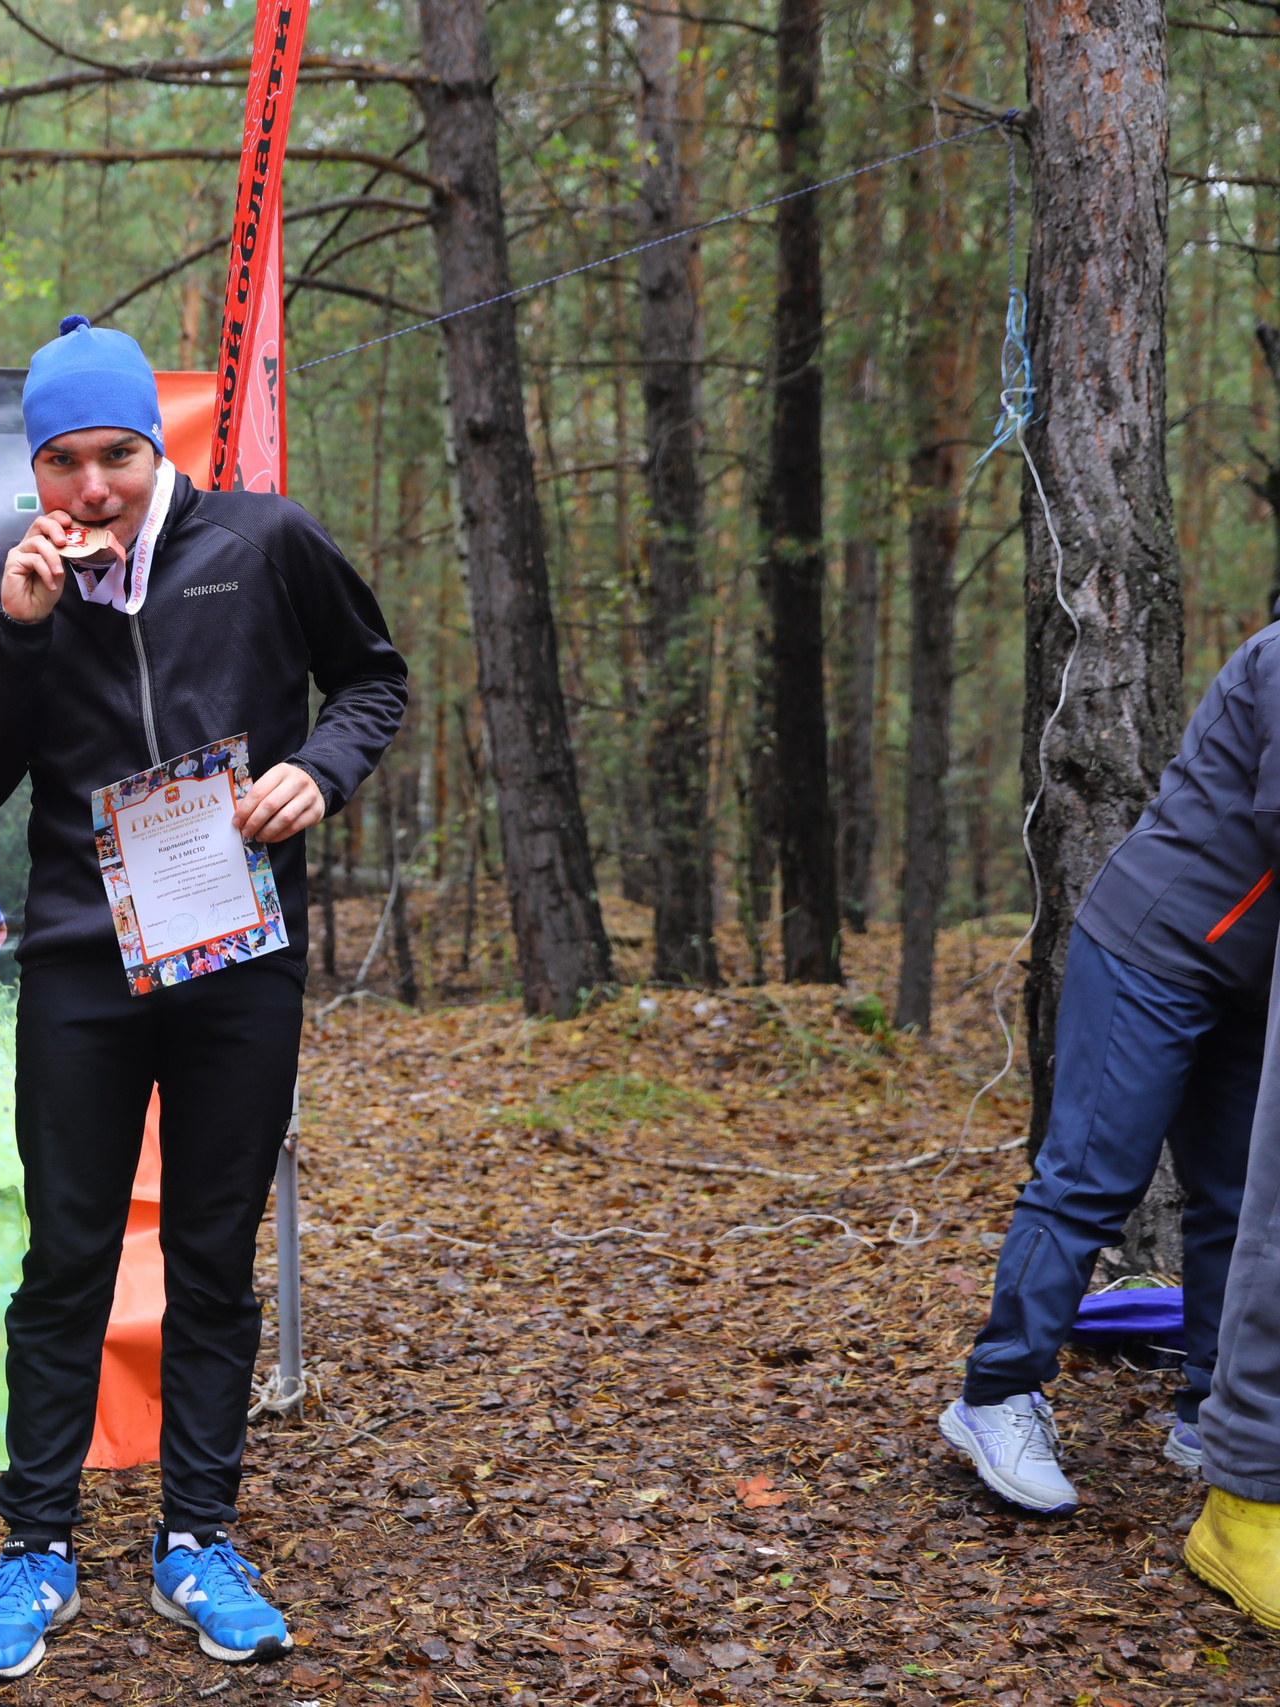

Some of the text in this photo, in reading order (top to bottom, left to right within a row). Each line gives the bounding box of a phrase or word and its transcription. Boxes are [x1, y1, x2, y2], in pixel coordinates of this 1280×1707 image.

[183, 581, 239, 598] SKIKROSS
[131, 793, 219, 833] ГРАМОТА
[194, 833, 210, 843] Егор
[183, 845, 206, 857] МЕСТО
